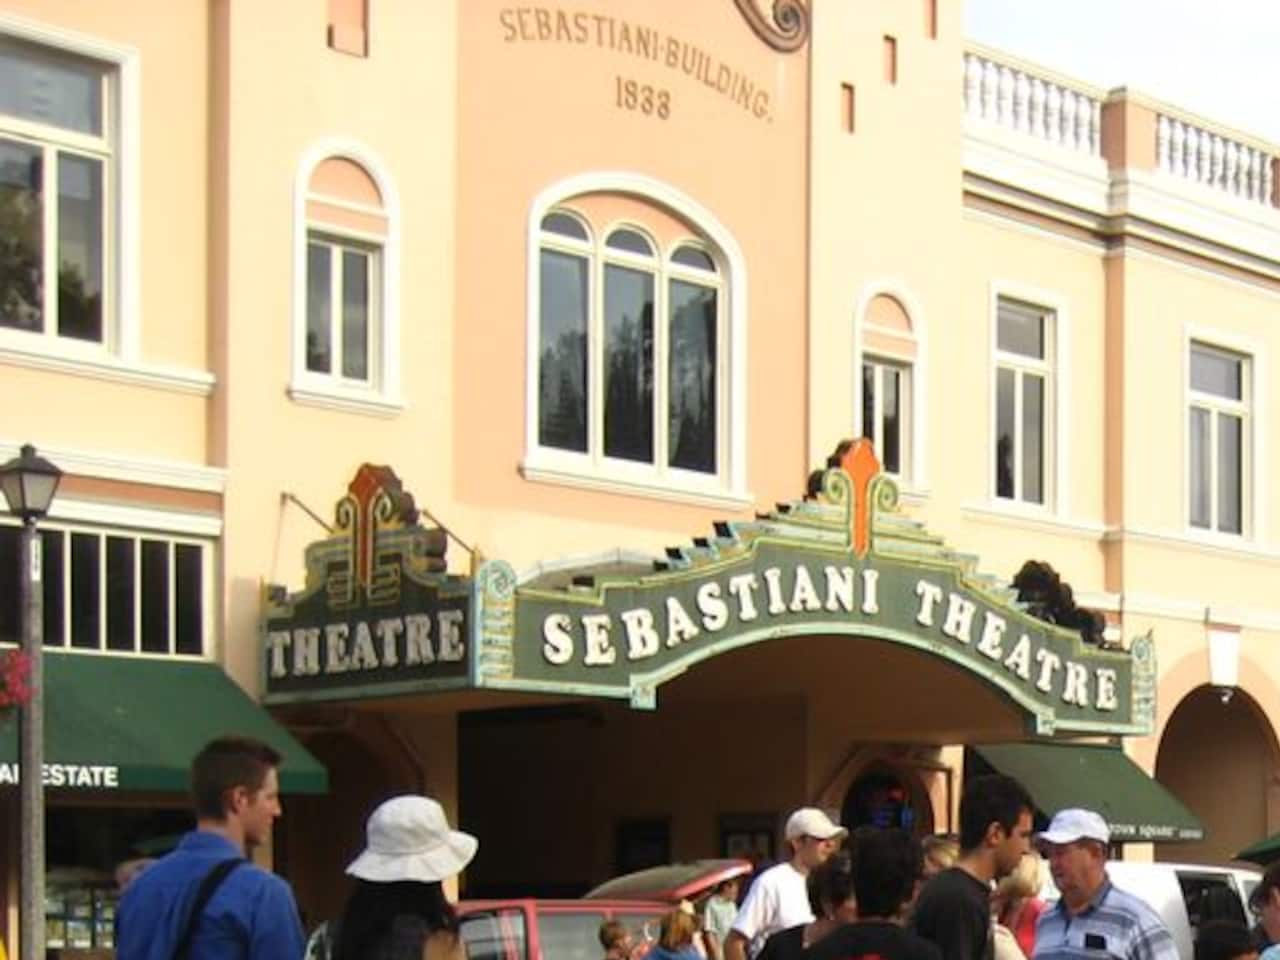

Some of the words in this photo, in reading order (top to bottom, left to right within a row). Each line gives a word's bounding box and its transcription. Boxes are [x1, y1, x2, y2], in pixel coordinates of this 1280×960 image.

[500, 8, 658, 60] SEBASTIANI
[267, 609, 465, 678] THEATRE
[543, 565, 879, 665] SEBASTIANI
[916, 580, 1118, 711] THEATRE
